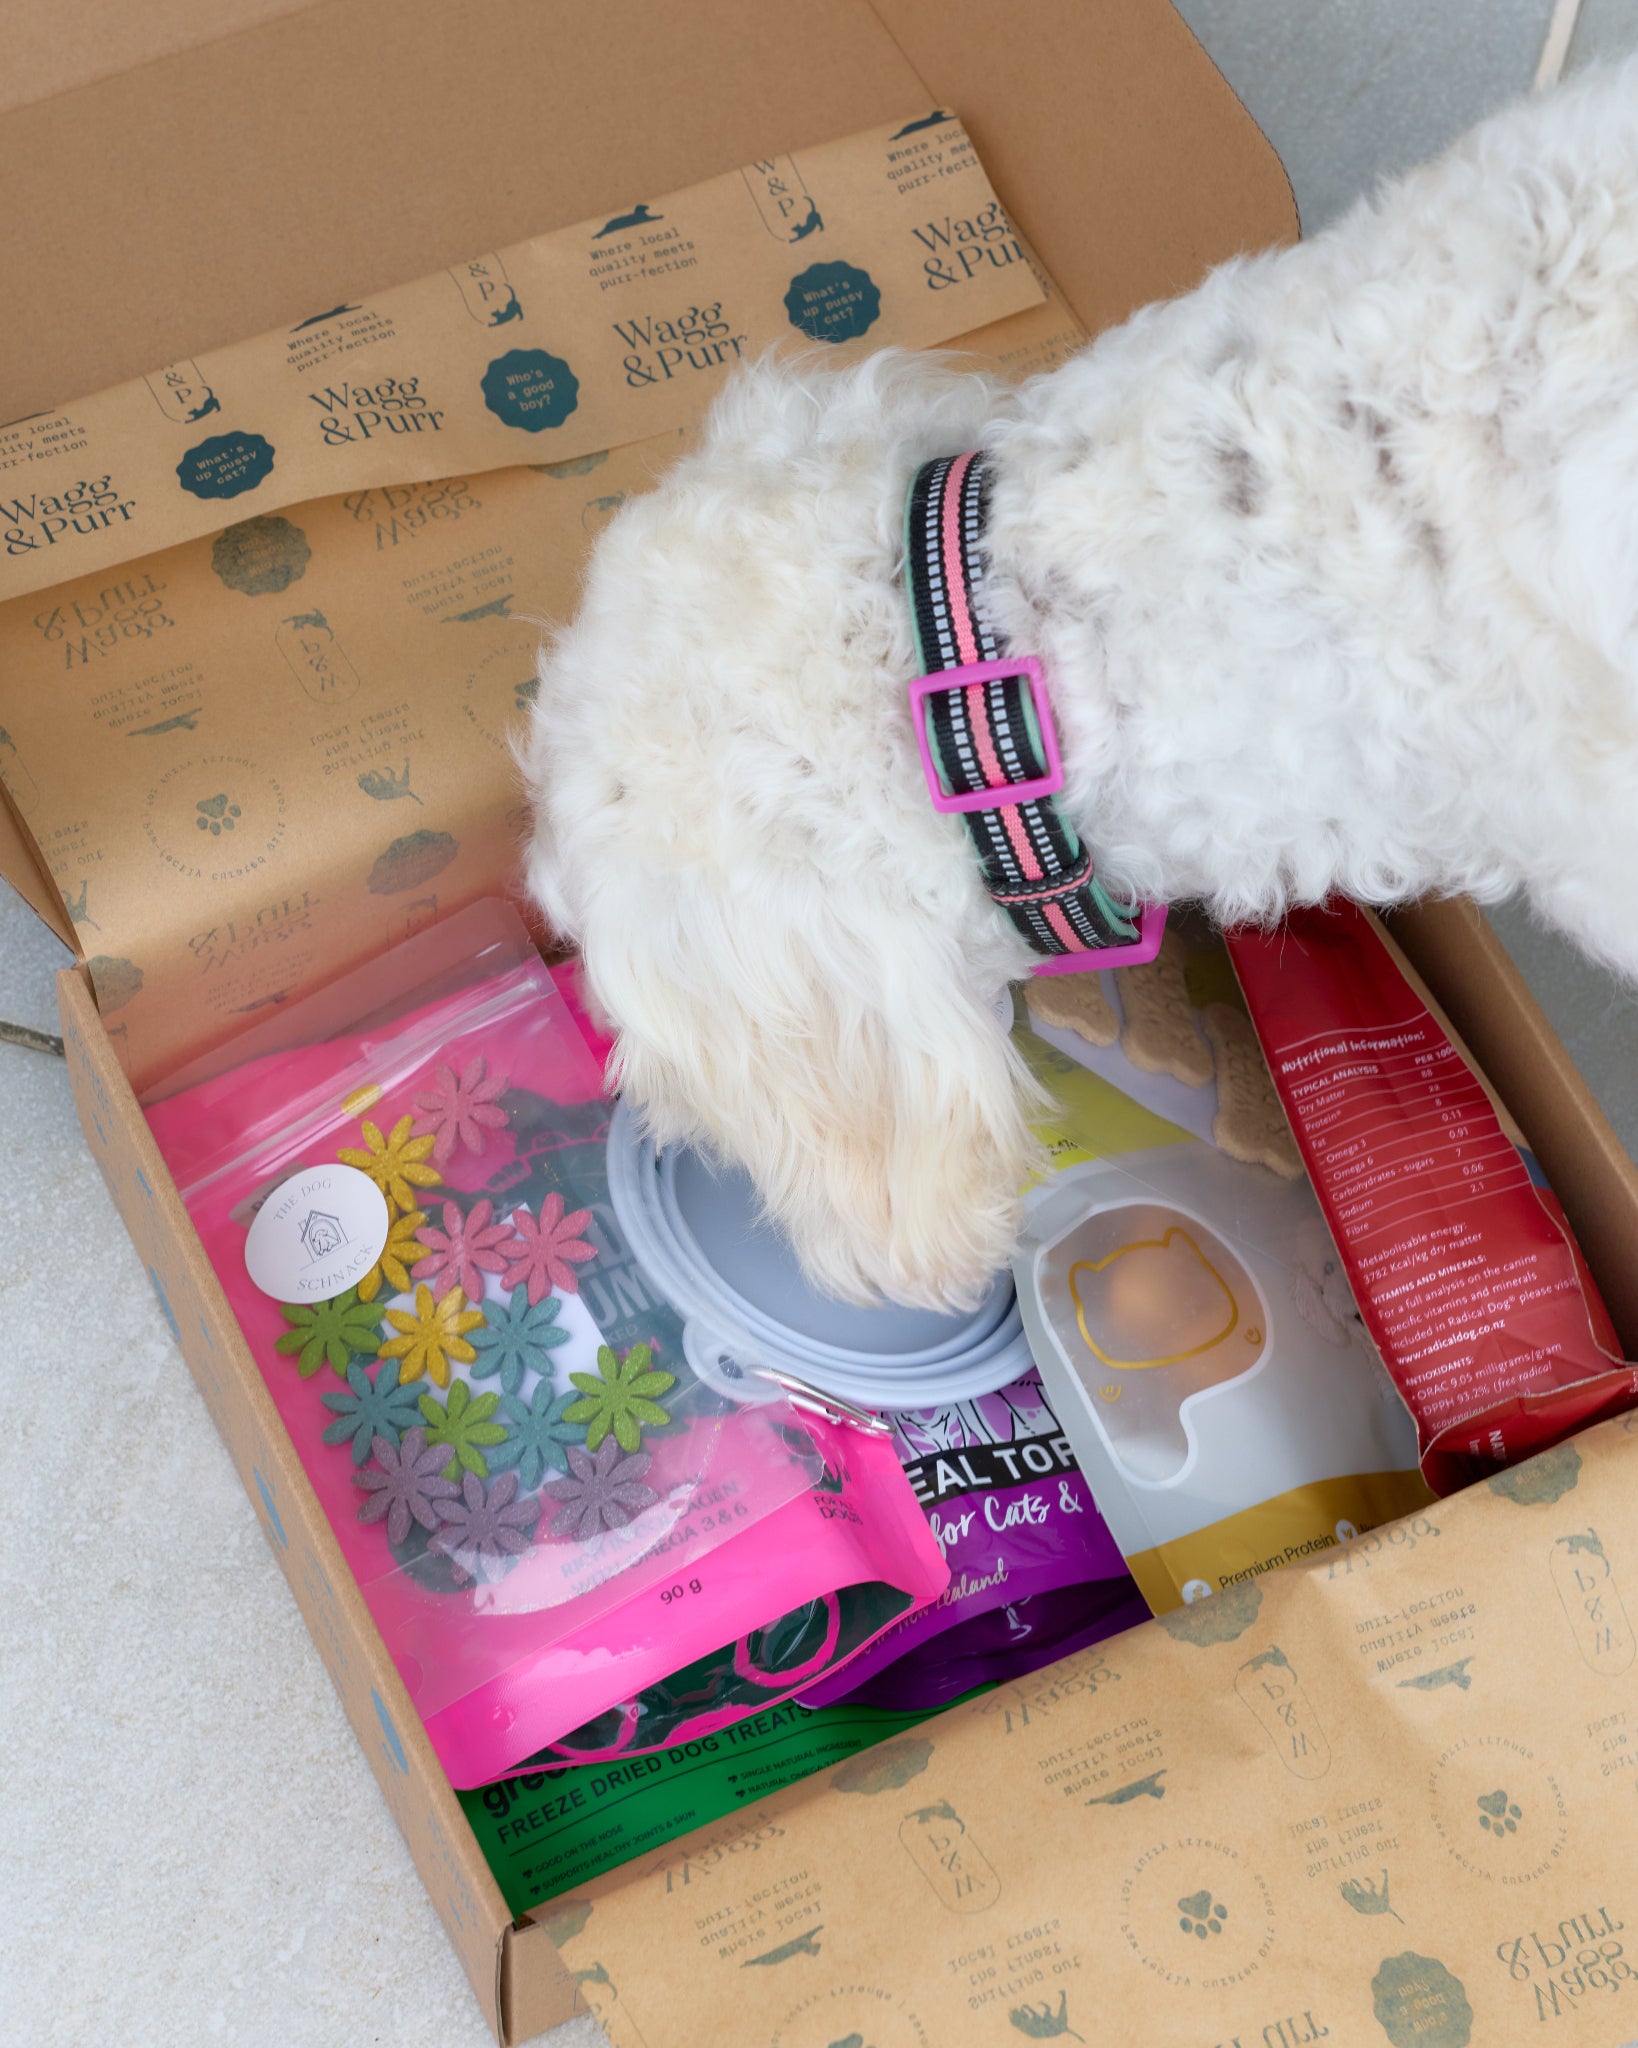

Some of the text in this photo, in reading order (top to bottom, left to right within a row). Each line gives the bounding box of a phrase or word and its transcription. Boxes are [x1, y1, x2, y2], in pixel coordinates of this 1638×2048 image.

[887, 140, 929, 163] Where
[887, 151, 943, 181] quality
[898, 155, 978, 195] purr-fecti
[589, 227, 680, 261] Where local
[589, 241, 695, 278] quality meets
[600, 255, 698, 291] purr-fection
[803, 280, 850, 303] What's
[803, 290, 863, 318] up pussy
[287, 312, 378, 351] Where local
[612, 302, 729, 350] Wagg
[823, 306, 854, 326] cat?
[287, 318, 393, 365] quality meets
[296, 329, 396, 373] purr-fection
[308, 377, 427, 413] Wagg
[506, 369, 543, 386] Who's
[508, 379, 554, 400] a good
[520, 395, 551, 412] boy?
[0, 427, 86, 456] lity meets
[29, 417, 71, 434] local
[0, 440, 88, 470] rr-fection
[195, 450, 257, 482] up pussy
[196, 445, 244, 470] What's
[217, 466, 247, 484] cat?
[0, 475, 118, 525] Wagg
[1281, 1031, 1425, 1074] Nutritional Information:
[1291, 1077, 1331, 1099] TYPICAL
[1333, 1065, 1378, 1082] ANALYSIS
[1414, 1055, 1434, 1066] PER
[1298, 1103, 1314, 1115] Dry
[1316, 1089, 1345, 1107] Matter
[1311, 1137, 1326, 1149] Fat
[1326, 1143, 1359, 1164] Omega
[1332, 1168, 1396, 1202] Carbohydrates
[1403, 1157, 1435, 1172] sugars
[1333, 1160, 1366, 1181] Omega
[274, 1196, 298, 1221] THE
[301, 1178, 332, 1198] DOG
[1339, 1199, 1374, 1220] Sodium
[1346, 1222, 1369, 1238] Fibre
[1358, 1222, 1467, 1269] Metabolisable energy:
[297, 1244, 373, 1291] SCHNACK
[1364, 1232, 1482, 1285] 3782 Kcal/kg dry matter
[1372, 1254, 1487, 1305] VITAMINS AND MINERALS:
[1378, 1308, 1395, 1320] For
[1405, 1294, 1422, 1308] full
[1425, 1279, 1465, 1302] analysis
[1467, 1273, 1481, 1284] on
[1483, 1266, 1500, 1279] the
[1503, 1254, 1537, 1272] canine
[1385, 1271, 1537, 1336] specific vitamins and minerals
[1390, 1326, 1433, 1350] included
[1435, 1322, 1445, 1333] in
[1448, 1307, 1485, 1327] Radical
[1519, 1285, 1552, 1306] please
[1397, 1319, 1505, 1365] www.radicaldog.co.nz
[1406, 1356, 1473, 1387] ANTIOXIDANTS:
[1417, 1382, 1449, 1400] ORAC
[1475, 1343, 1561, 1377] milligrams/gram
[1423, 1397, 1454, 1416] DPPH
[1518, 1360, 1552, 1382] radical
[906, 1436, 1075, 1503] EAL TOP
[701, 1517, 715, 1532] 3
[718, 1509, 732, 1525] &
[733, 1501, 748, 1515] 6
[930, 1480, 1083, 1561] for Cats &
[1218, 1533, 1335, 1590] Premium Protein
[660, 1578, 702, 1605] 90 g
[497, 1703, 813, 1844] FREEZE DRIED DOG TREATS
[740, 1764, 774, 1780] SINGLE
[774, 1750, 815, 1769] NATURAL
[748, 1776, 788, 1794] NATURAL
[535, 1824, 624, 1873] GOOD ON THE NOSE
[543, 1862, 591, 1890] SUPPORTS
[591, 1841, 632, 1865] HEALTHY
[633, 1823, 665, 1847] JOINTS
[673, 1809, 696, 1825] SKIN
